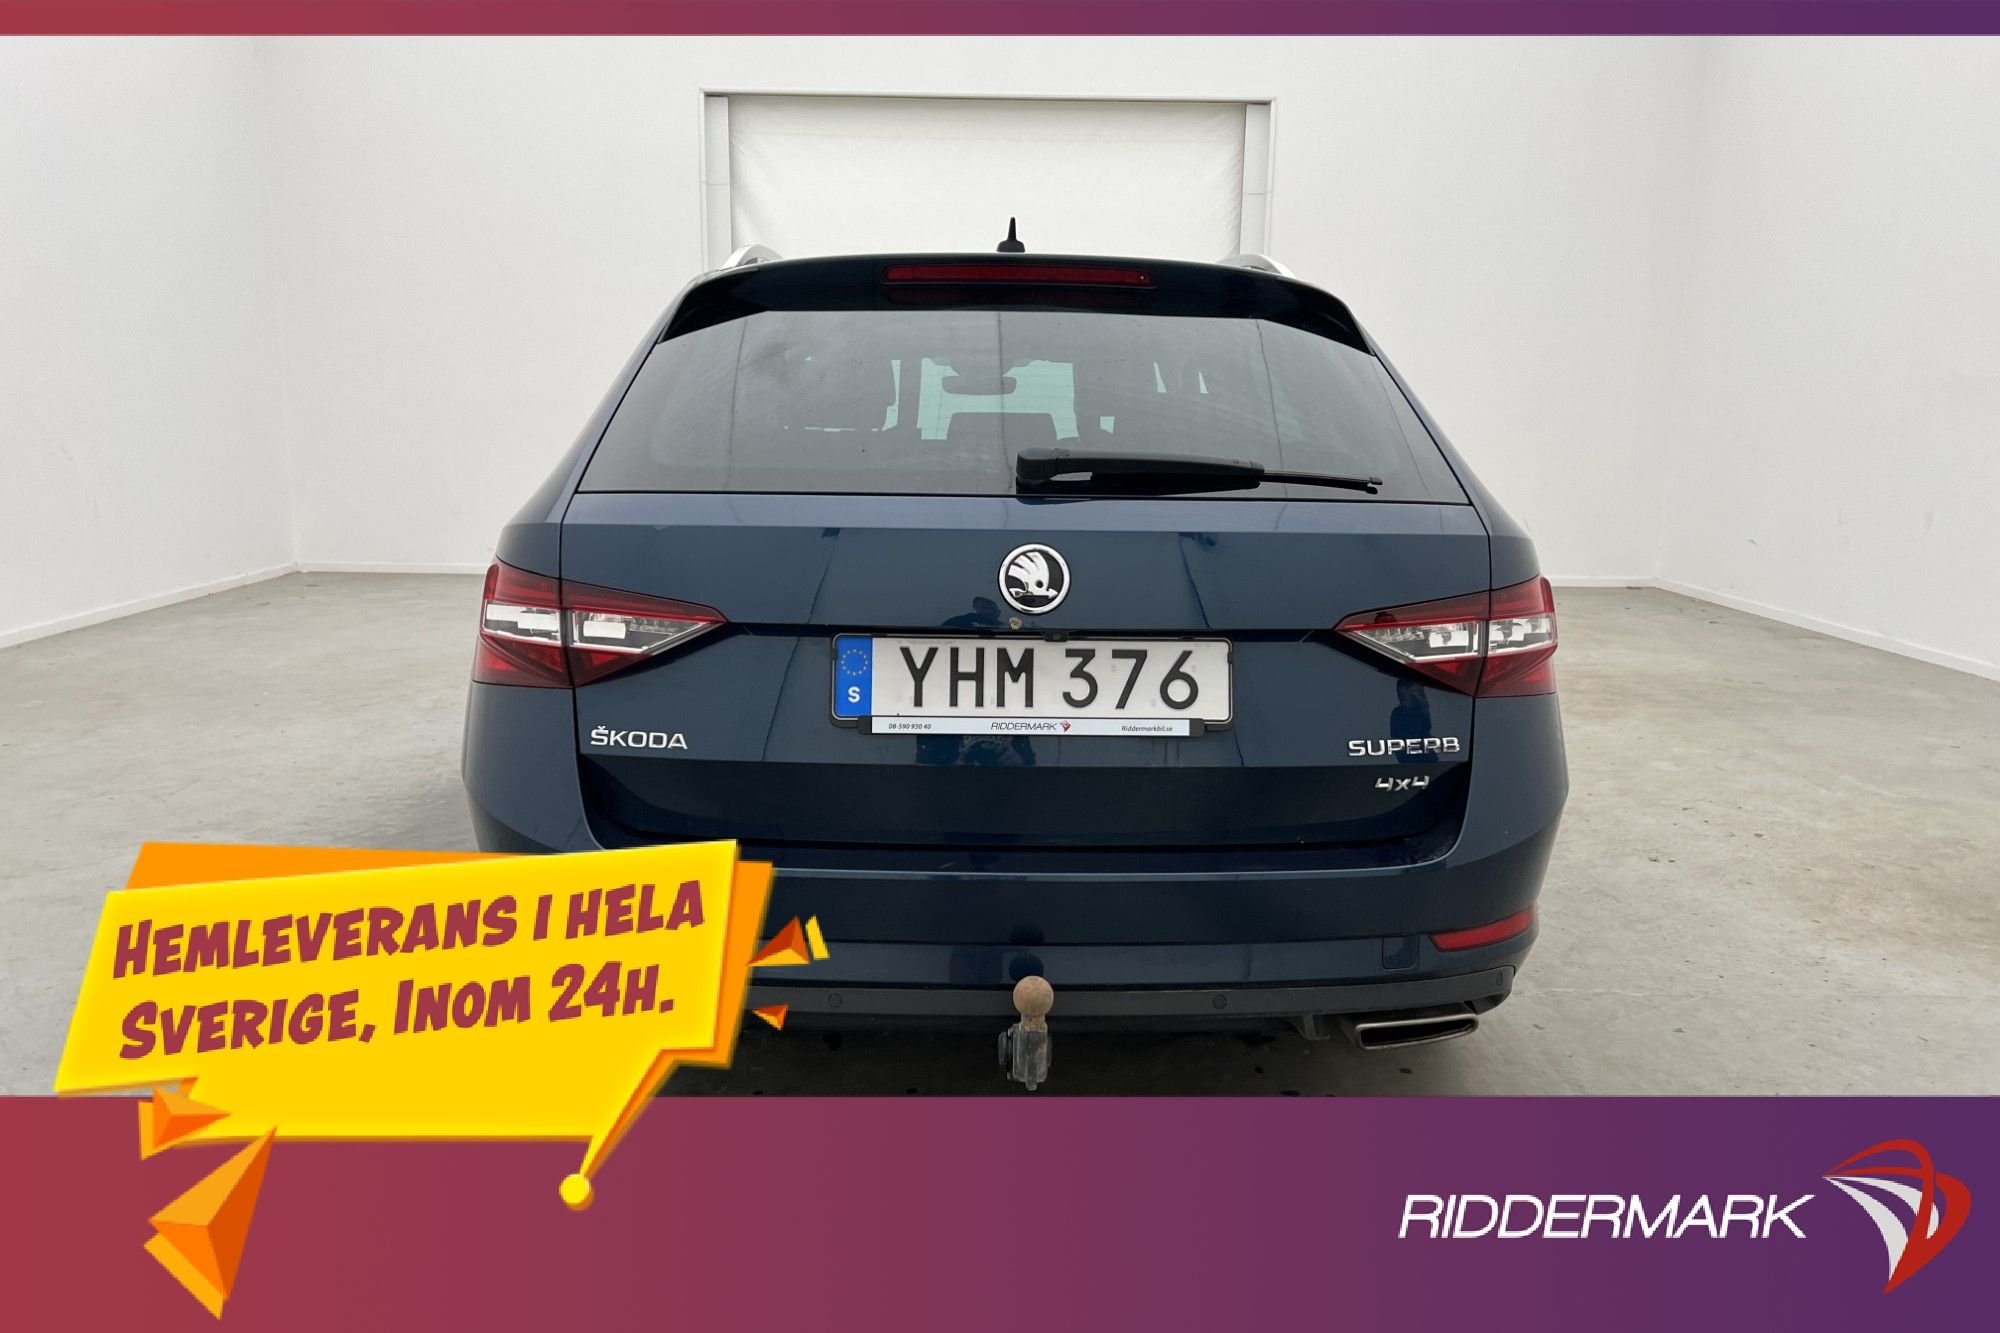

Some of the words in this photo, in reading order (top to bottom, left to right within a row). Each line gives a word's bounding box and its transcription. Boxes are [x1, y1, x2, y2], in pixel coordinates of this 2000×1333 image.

[900, 647, 1034, 707] YHM
[1063, 649, 1199, 709] 376
[848, 686, 860, 702] S
[991, 722, 1057, 731] RIDDERMARK
[590, 725, 688, 750] ŠKODA
[1348, 737, 1460, 756] SUPERB
